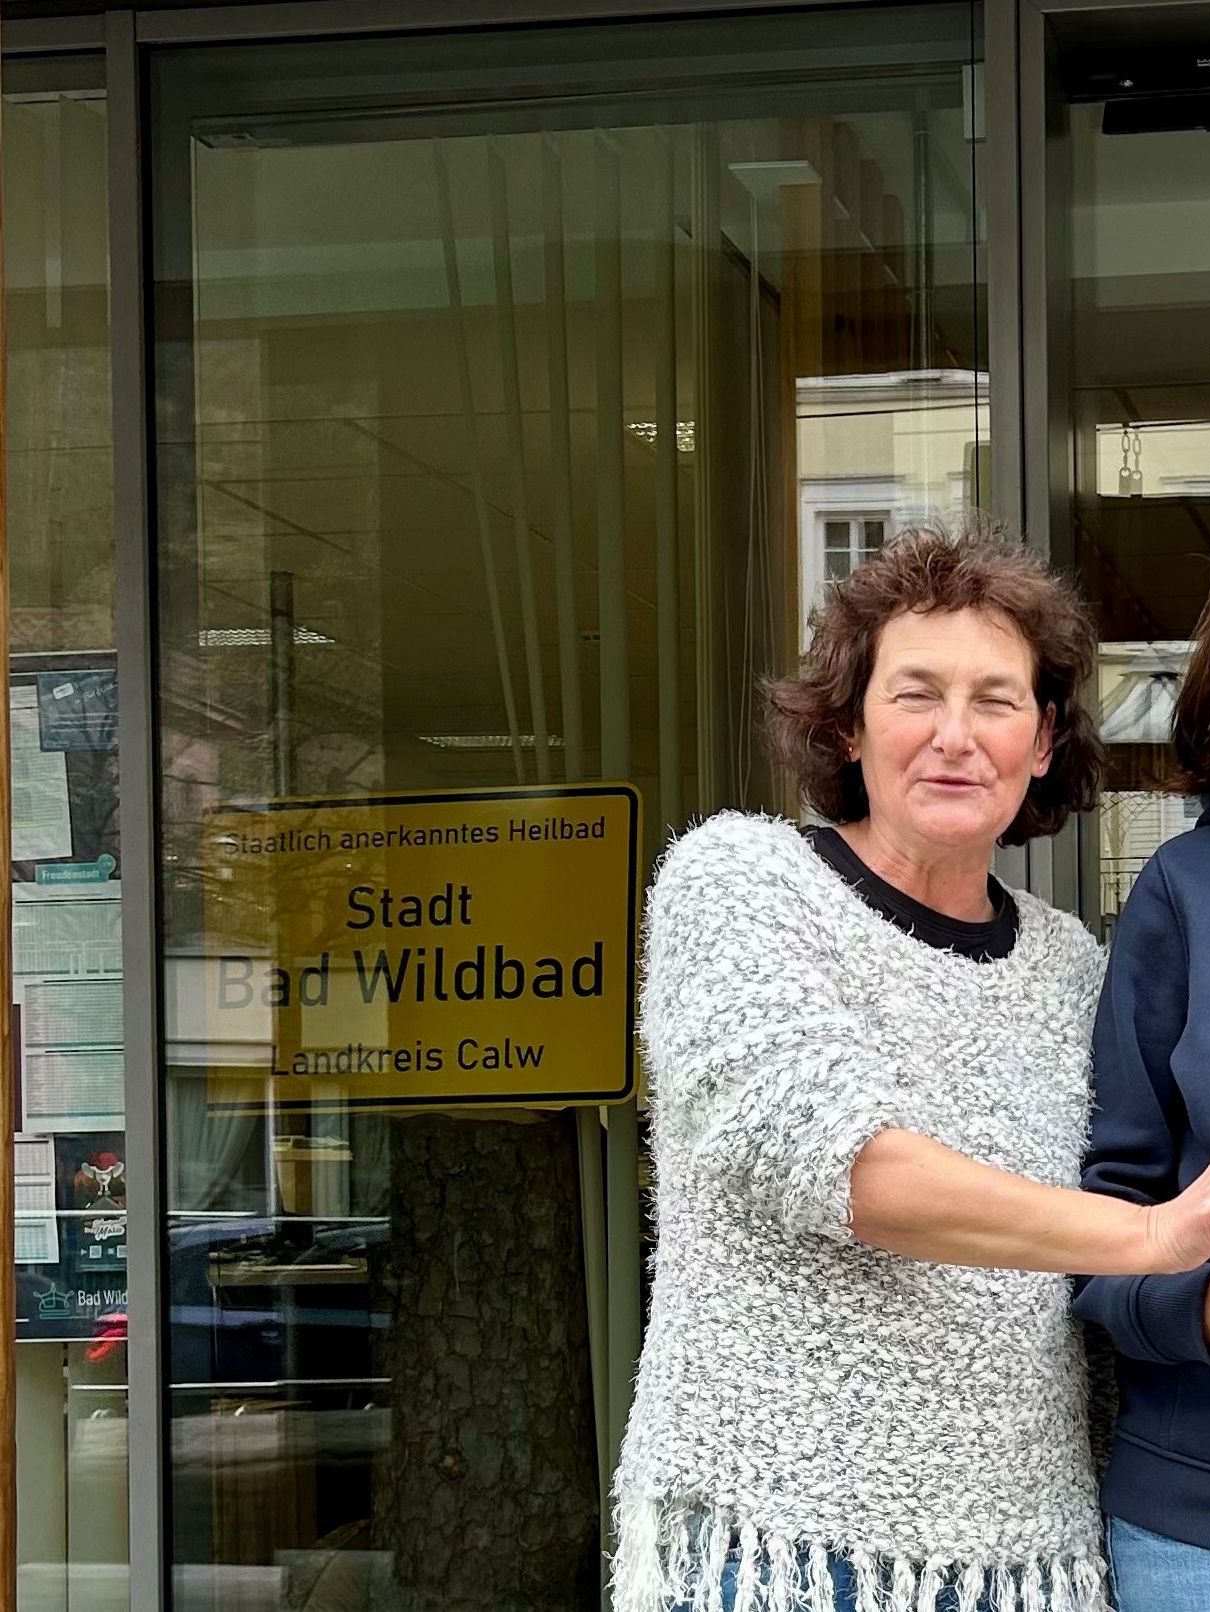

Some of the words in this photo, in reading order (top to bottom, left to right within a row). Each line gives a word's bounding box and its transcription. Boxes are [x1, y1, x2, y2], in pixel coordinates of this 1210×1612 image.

[224, 828, 331, 855] Staatlich
[340, 822, 499, 850] anerkanntes
[509, 816, 606, 842] Heilbad
[41, 869, 100, 881] Freudenstadt
[346, 883, 472, 930] Stadt
[217, 951, 330, 1010] Bad
[353, 941, 604, 1004] Wildbad
[270, 1039, 443, 1077] Landkreis
[457, 1037, 544, 1070] Calw
[78, 1289, 100, 1306] Bad
[103, 1289, 128, 1305] Wild
